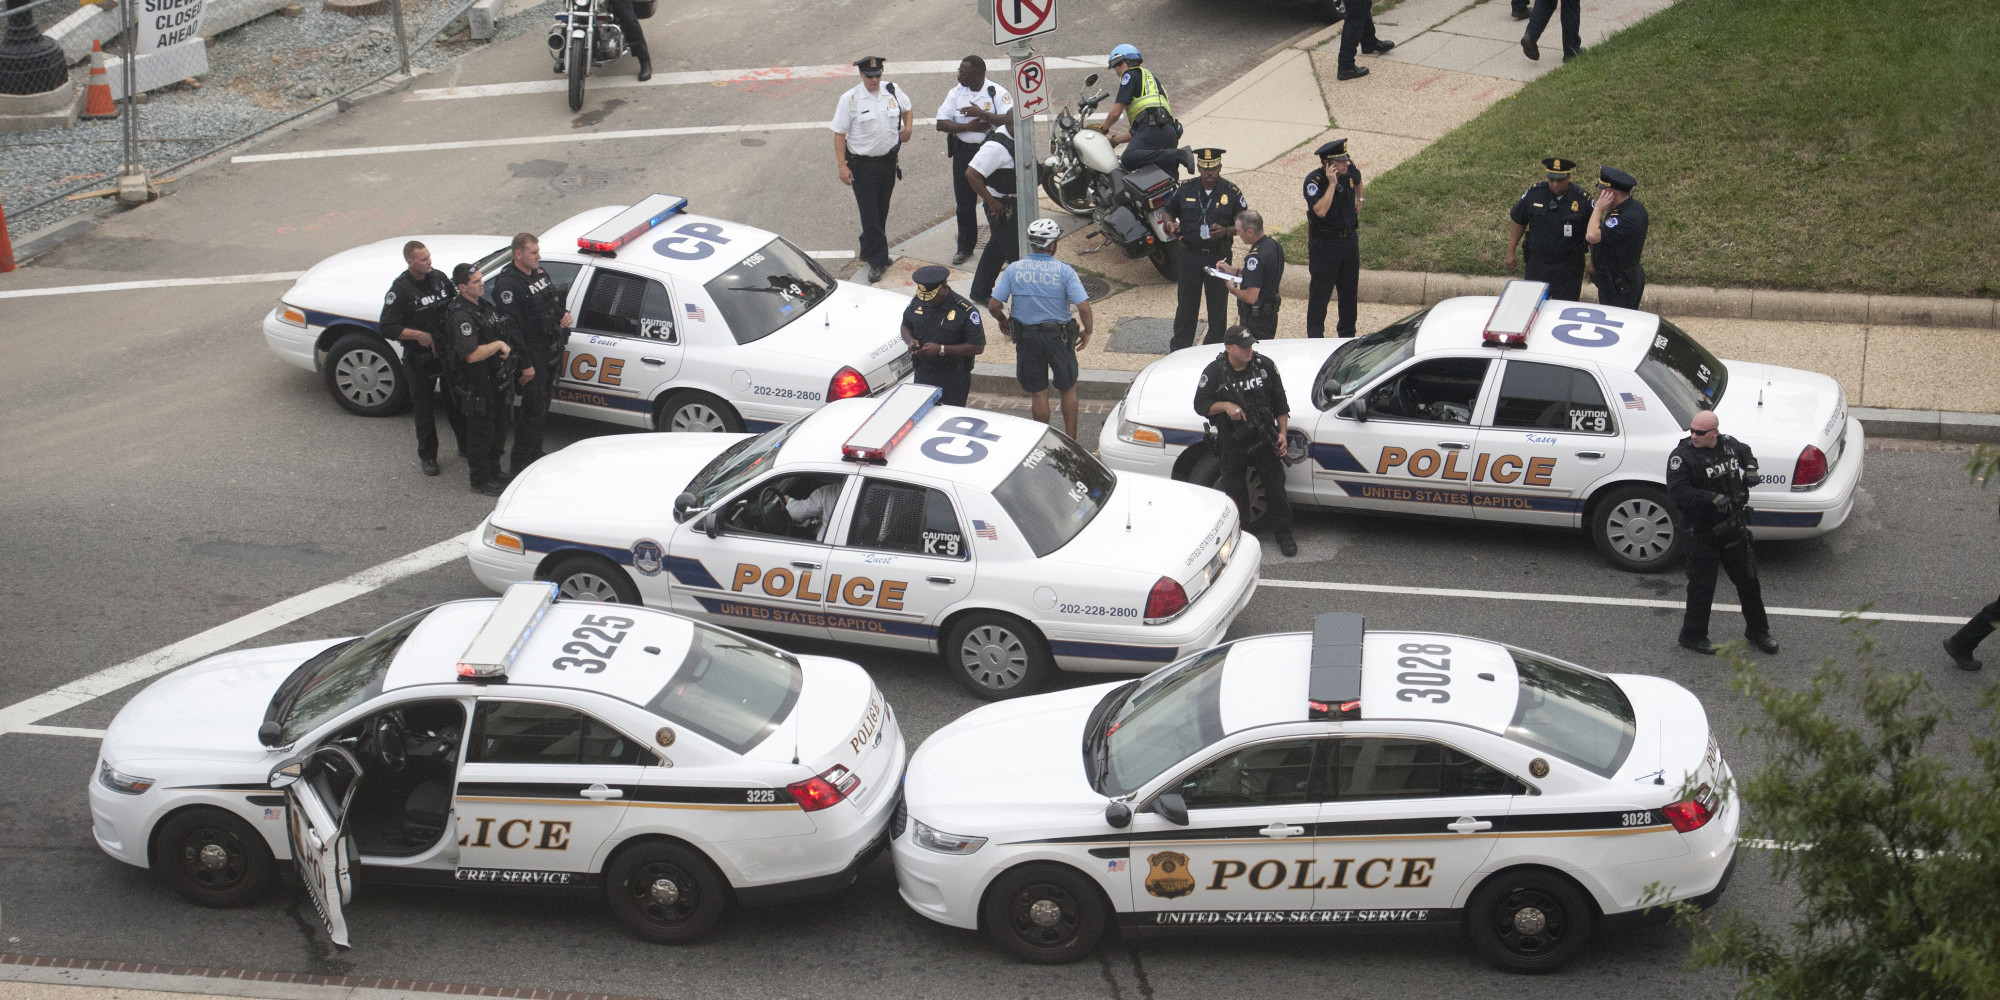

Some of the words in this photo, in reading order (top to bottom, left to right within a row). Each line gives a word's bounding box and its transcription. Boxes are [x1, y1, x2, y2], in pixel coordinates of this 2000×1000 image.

[145, 0, 195, 12] SIDE
[156, 1, 203, 30] CLOSED
[156, 20, 198, 48] AHEAD
[653, 223, 731, 261] CP
[1015, 271, 1060, 286] POLICE
[780, 283, 802, 302] K-9
[640, 317, 673, 329] CAUTION
[1551, 307, 1624, 348] CP
[641, 325, 670, 340] K-9
[887, 334, 903, 348] STATE
[561, 351, 625, 386] ICE
[1697, 364, 1711, 383] K-9
[559, 389, 609, 406] CAPITOL
[753, 385, 821, 401] 202-228-2800
[1569, 409, 1608, 419] CAUTION
[1571, 417, 1606, 431] K-9
[920, 416, 1002, 465] CP
[1525, 433, 1559, 446] Kasey
[1376, 446, 1557, 486] POLICE
[1068, 481, 1089, 502] K-9
[1362, 486, 1412, 500] UNITED
[1415, 490, 1469, 505] STATES
[1472, 494, 1533, 510] CAPITOL
[922, 531, 960, 542] CAUTION
[924, 539, 959, 556] K-9
[732, 562, 908, 611] POLICE
[720, 603, 770, 619] UNITED
[773, 608, 826, 626] STATES
[827, 613, 886, 633] CAPITOL
[1060, 603, 1138, 618] 202-228-2800
[552, 614, 635, 674] 3225
[1396, 643, 1452, 704] 3028
[850, 699, 880, 755] POLICE
[746, 789, 775, 803] 3225
[1621, 811, 1652, 826] 3028
[456, 868, 500, 881] CRET
[501, 870, 571, 884] SERVICE
[1205, 856, 1437, 891] POLICE
[1156, 912, 1220, 925] UNITED
[1223, 911, 1285, 924] STATES
[1288, 910, 1353, 923] SECRET
[1357, 909, 1429, 922] SERVICE
